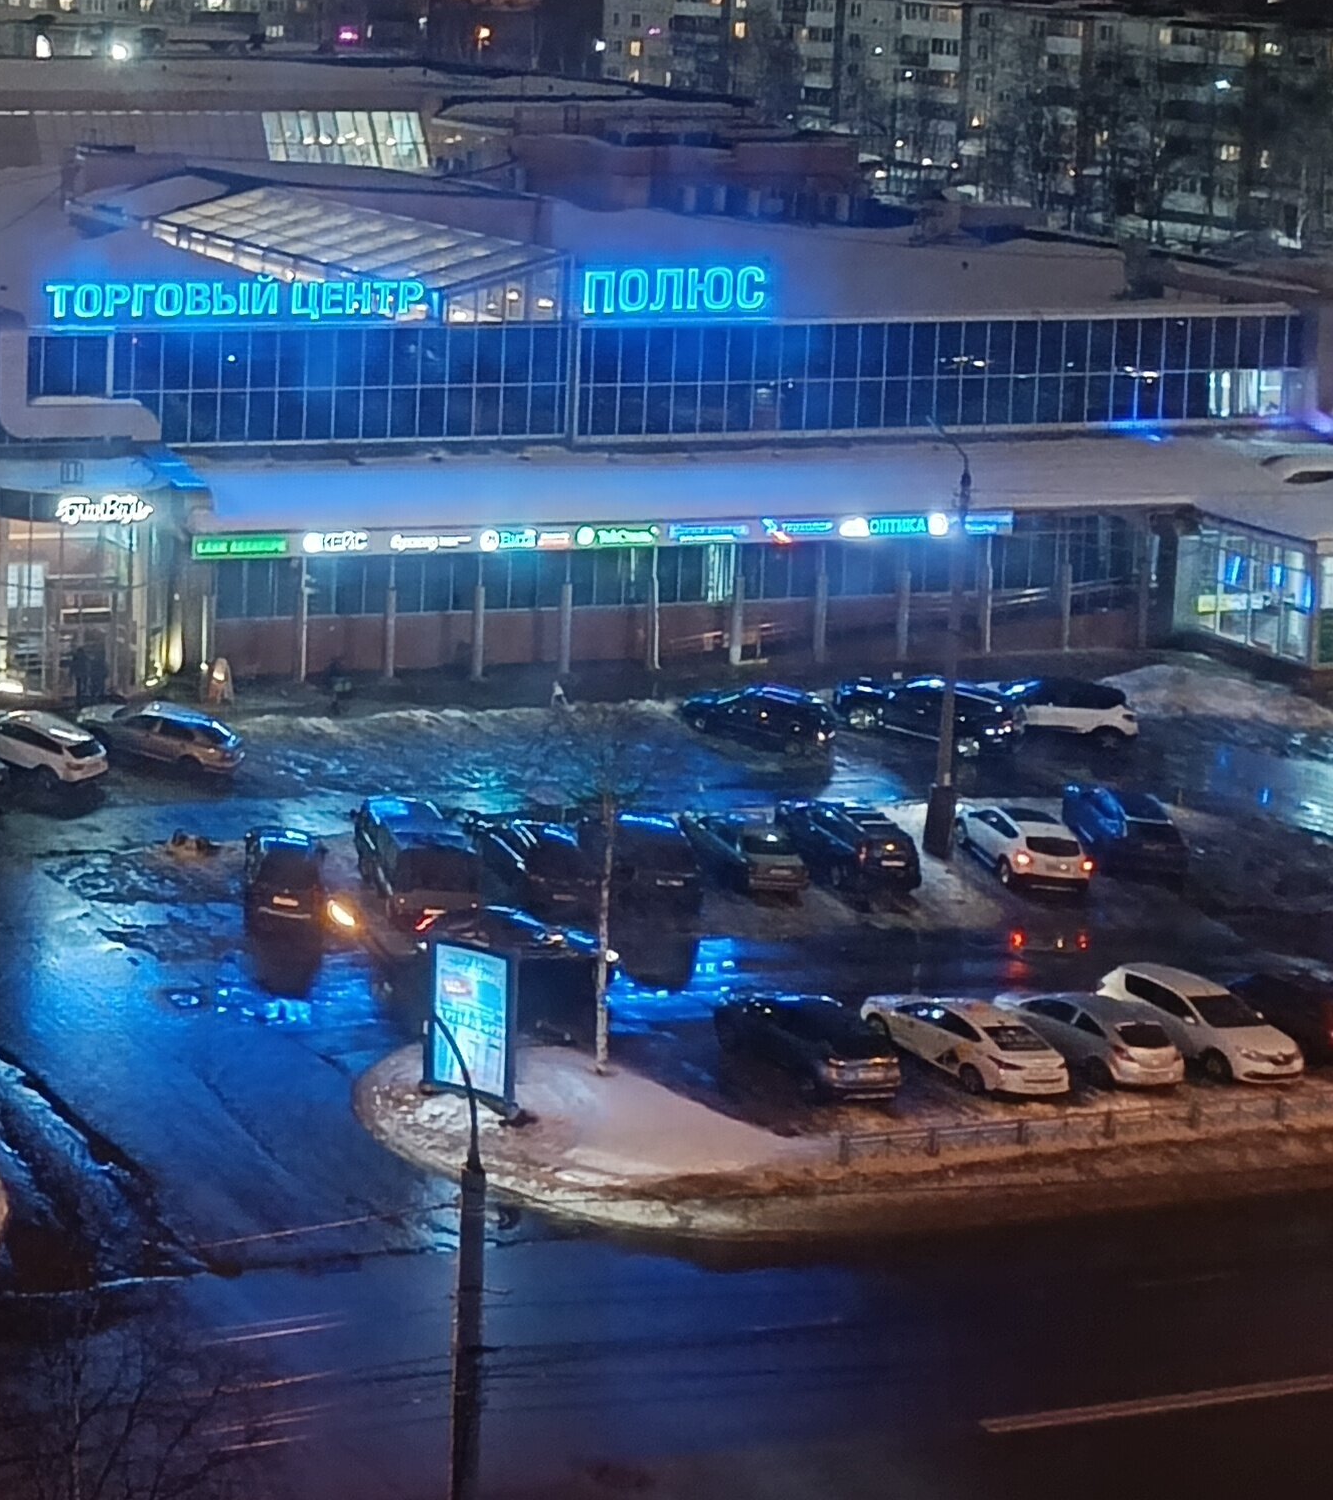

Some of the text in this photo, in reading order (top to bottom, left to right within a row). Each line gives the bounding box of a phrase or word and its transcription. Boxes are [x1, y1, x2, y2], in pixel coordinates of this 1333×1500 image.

[46, 274, 425, 320] ТОРГОВЫЙ ЦЕНТР
[583, 265, 766, 314] ПОЛЮС
[869, 518, 927, 534] ОПТИКА
